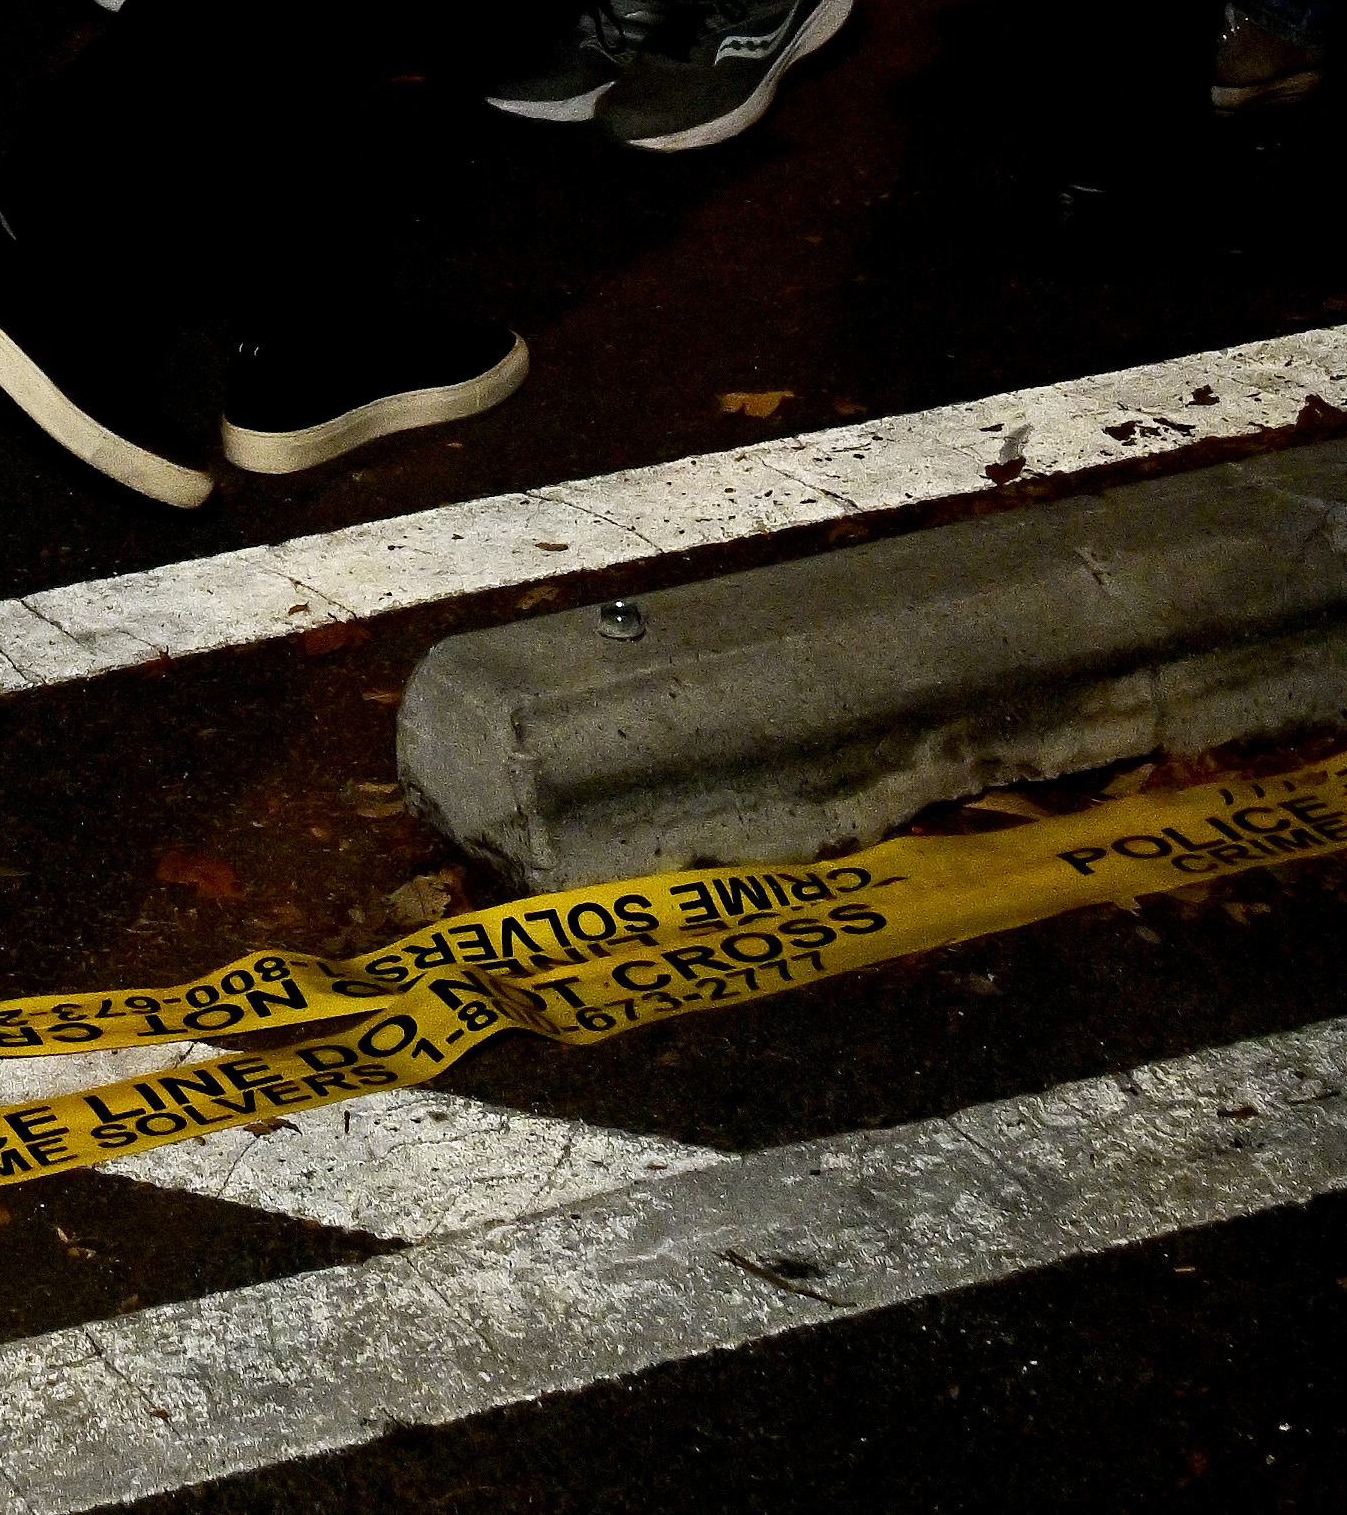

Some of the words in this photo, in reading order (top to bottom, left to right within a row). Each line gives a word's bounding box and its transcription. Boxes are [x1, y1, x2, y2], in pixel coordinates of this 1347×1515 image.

[1057, 796, 1346, 876] POLICE
[1170, 817, 1347, 874] CRIME
[670, 867, 872, 923] CRIME
[365, 894, 659, 985] SOLVERS
[82, 1056, 285, 1123] LINE
[296, 1014, 419, 1074] DO
[611, 903, 888, 992] CROSS
[137, 979, 306, 1036] NOT
[89, 1063, 399, 1148] SOLVERS
